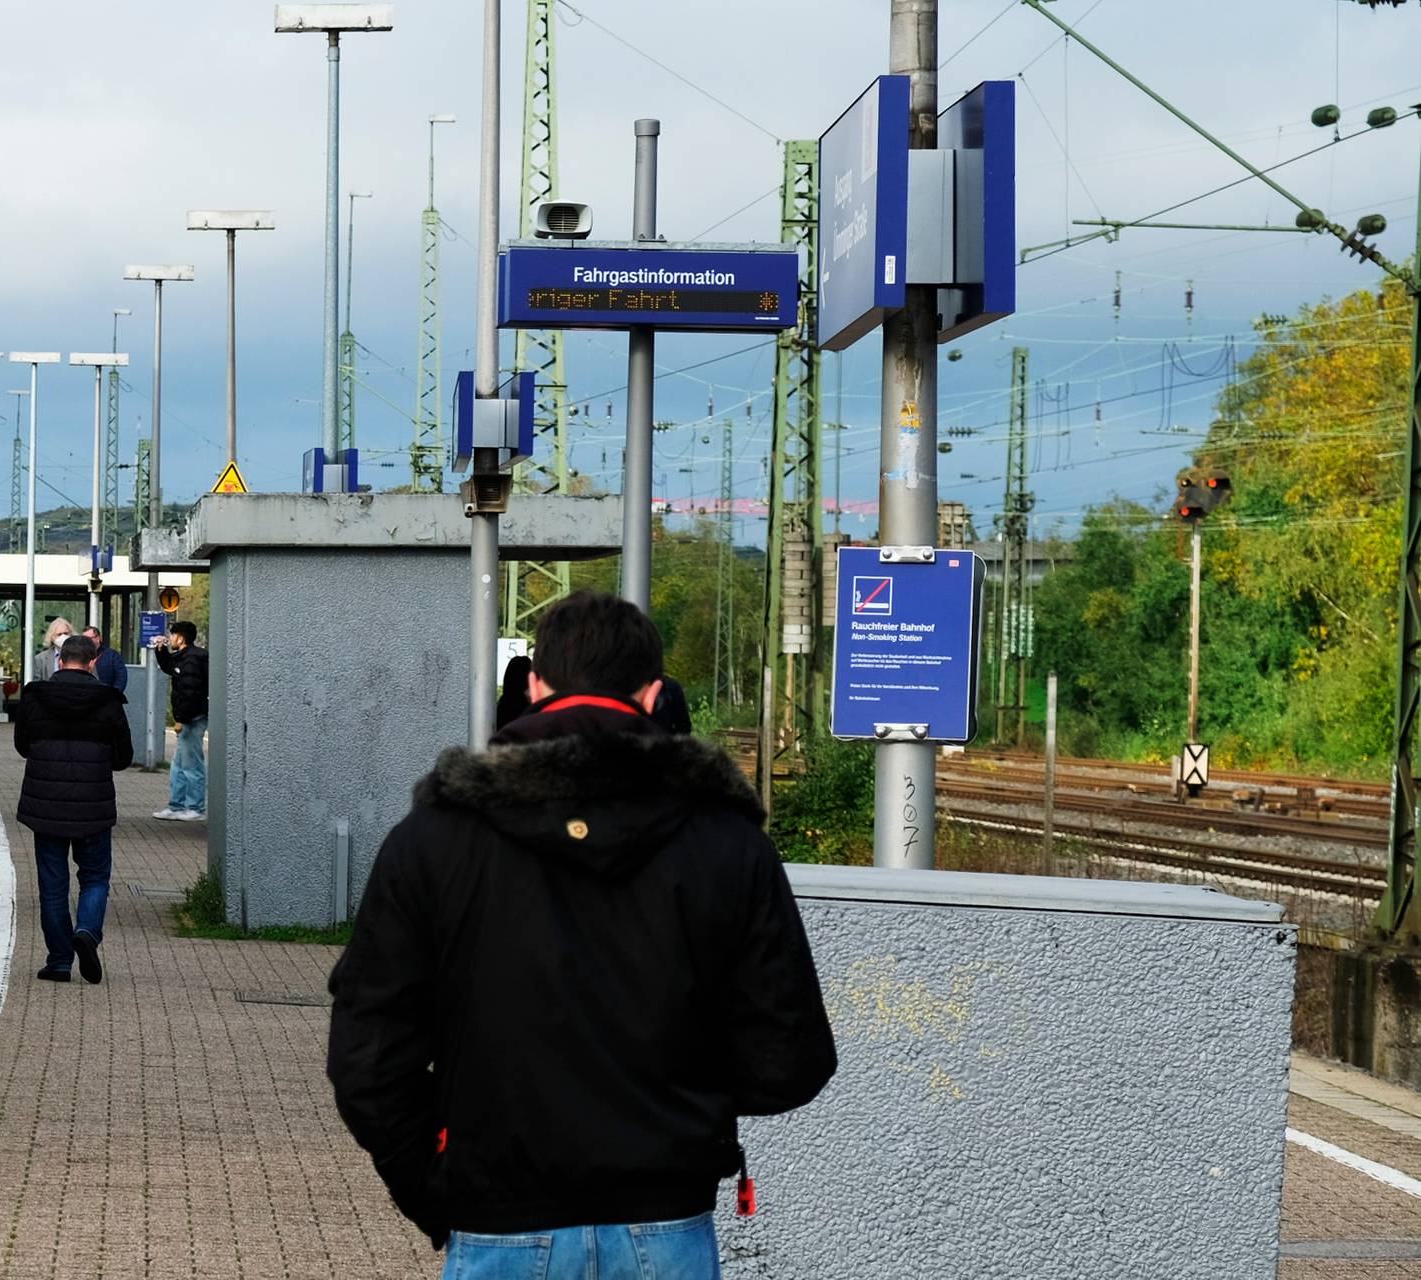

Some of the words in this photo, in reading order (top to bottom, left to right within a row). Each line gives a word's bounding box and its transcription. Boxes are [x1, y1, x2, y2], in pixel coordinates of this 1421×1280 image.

[573, 266, 735, 286] Fahrgastinformation
[609, 289, 681, 310] Fahrt
[851, 621, 899, 631] Rauchfreier
[900, 623, 935, 633] Bahnhof
[851, 633, 897, 643] Non-Smoking
[898, 634, 923, 642] Station
